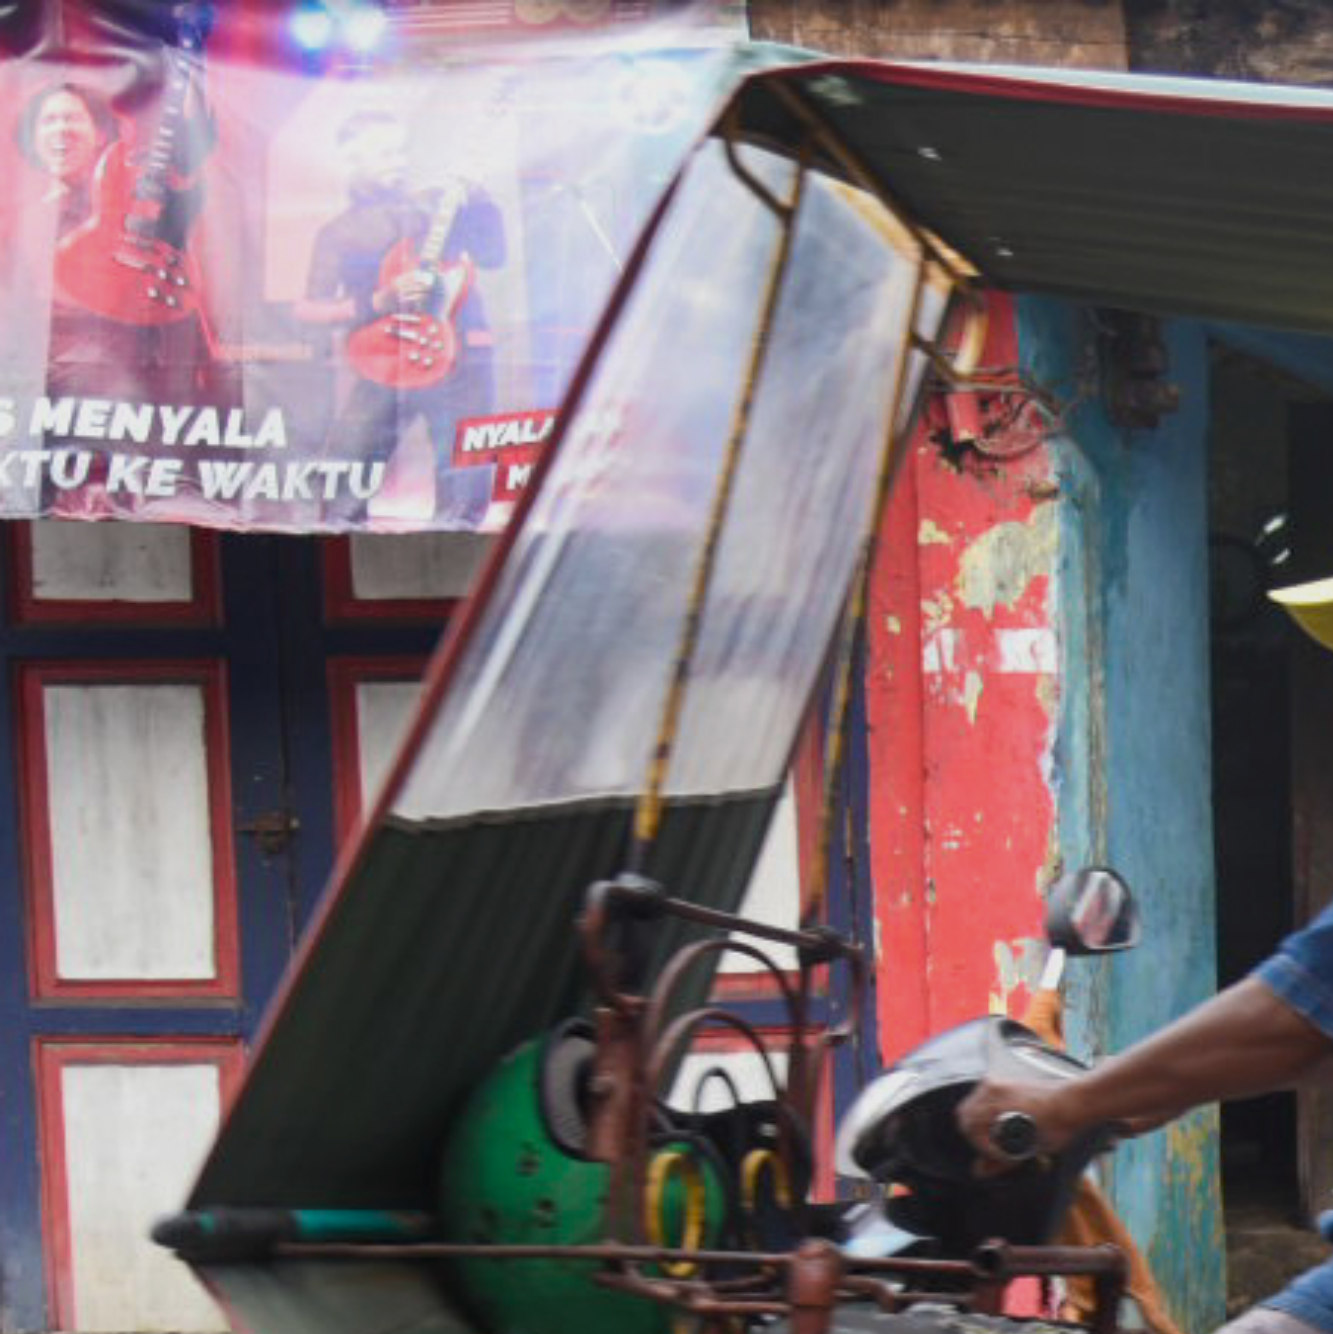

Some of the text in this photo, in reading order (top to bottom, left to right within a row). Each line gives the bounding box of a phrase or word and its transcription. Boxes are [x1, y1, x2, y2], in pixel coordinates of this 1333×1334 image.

[29, 397, 287, 448] MENYALA
[106, 453, 183, 496] KE
[198, 462, 386, 500] WAKTU
